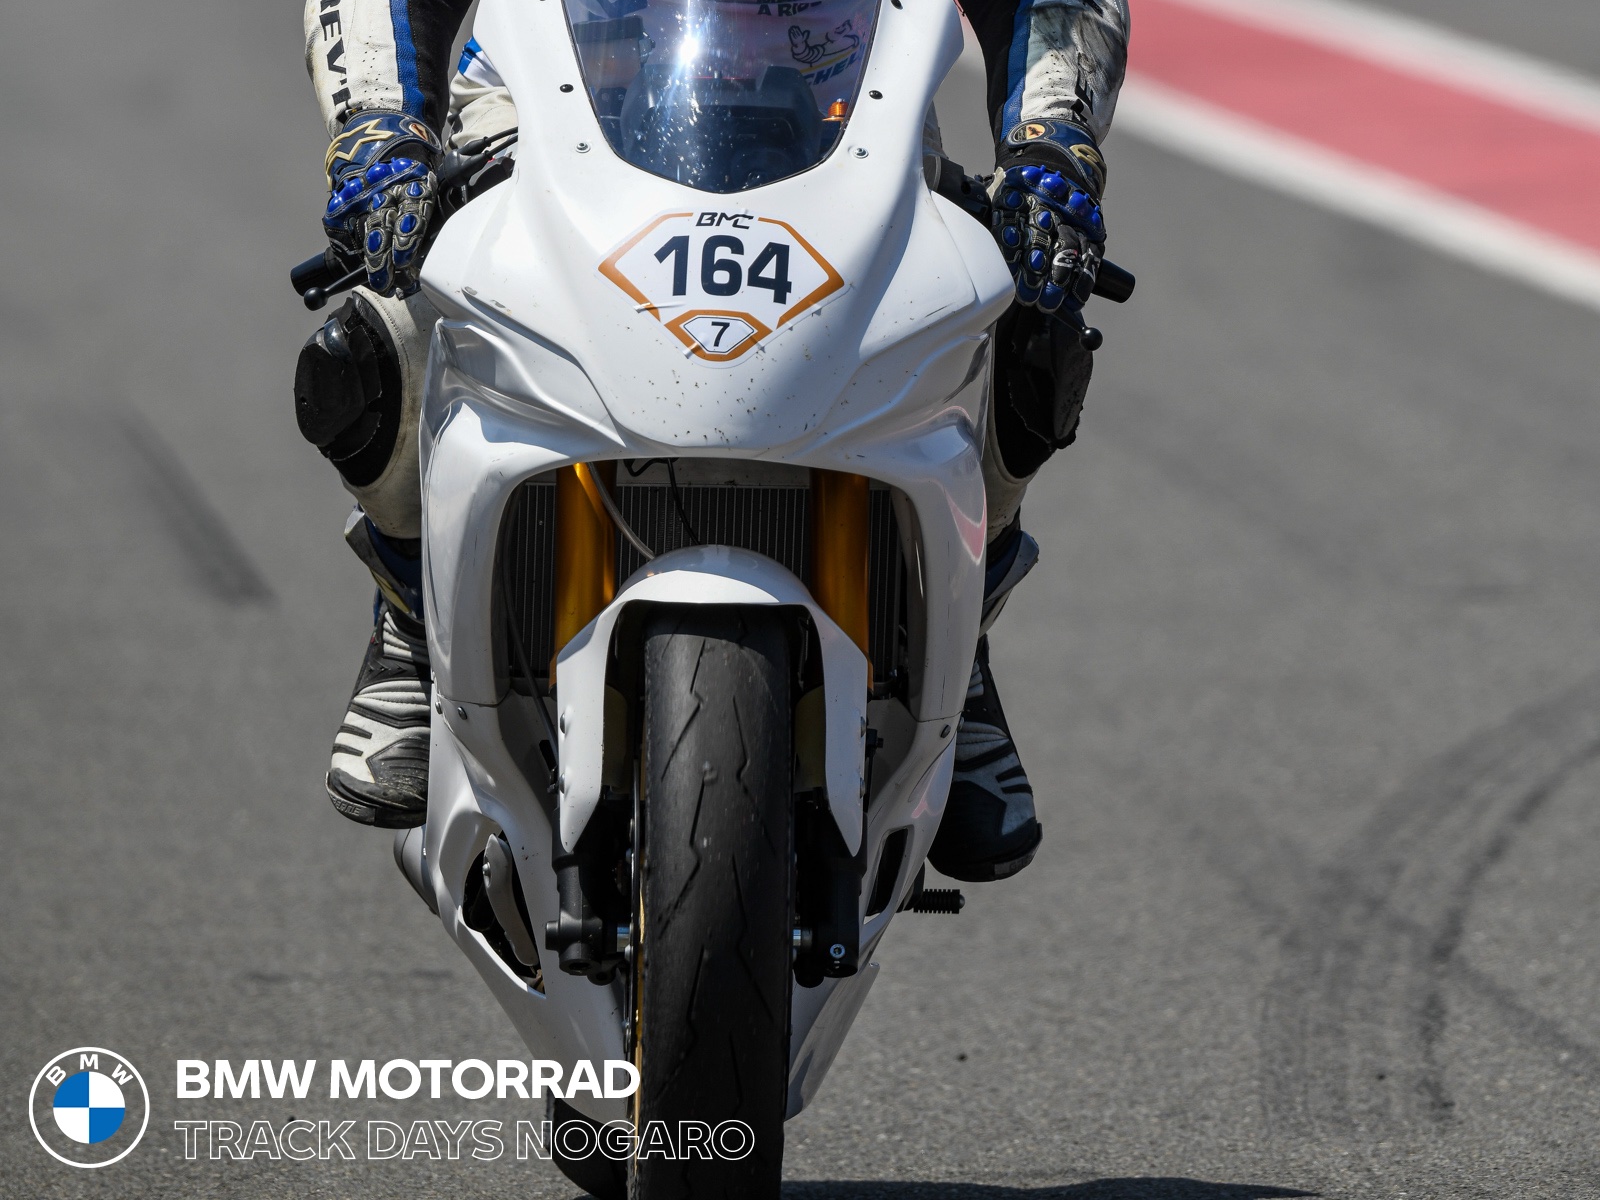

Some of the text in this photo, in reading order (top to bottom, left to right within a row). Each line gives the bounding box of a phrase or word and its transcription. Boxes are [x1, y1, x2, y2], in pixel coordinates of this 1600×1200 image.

[757, 3, 772, 16] A
[695, 212, 754, 230] BMC
[653, 234, 793, 305] 164
[711, 321, 731, 347] 7
